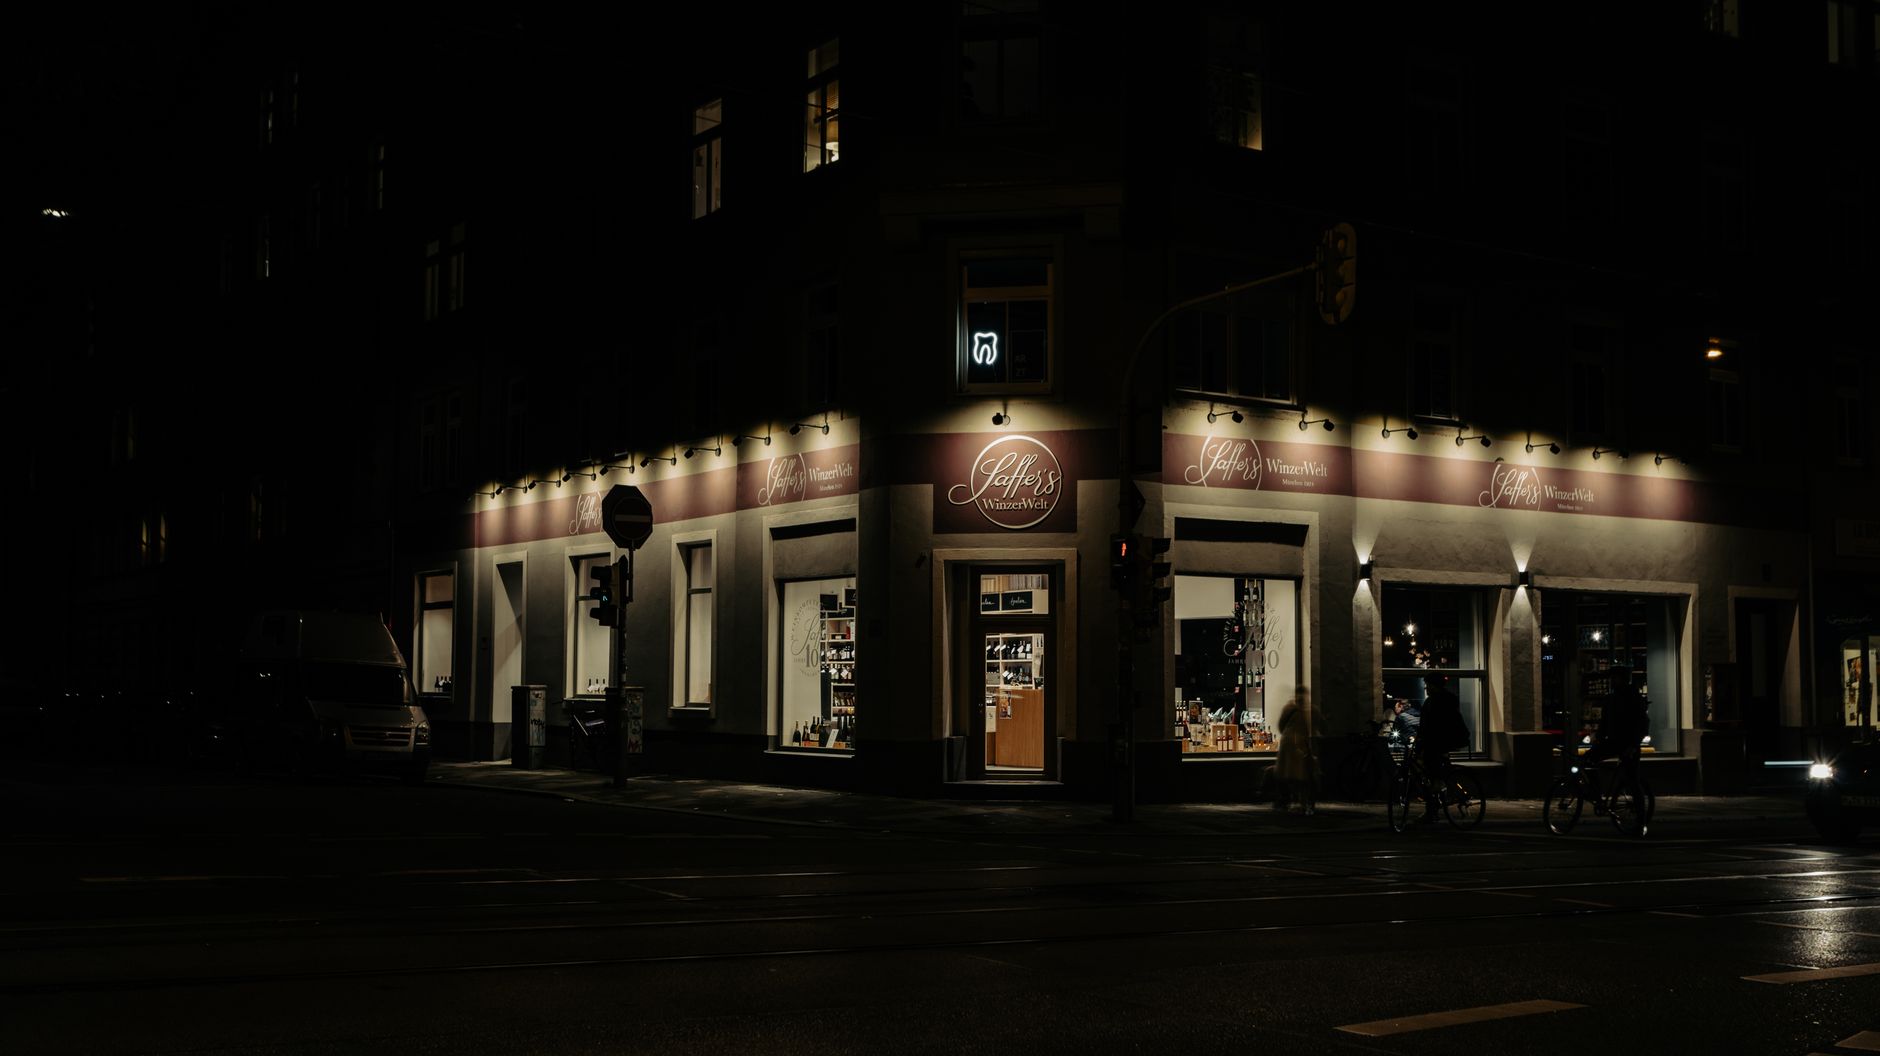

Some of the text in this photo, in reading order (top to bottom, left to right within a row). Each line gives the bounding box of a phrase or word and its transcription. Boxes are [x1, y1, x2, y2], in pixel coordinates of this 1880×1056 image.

[808, 463, 853, 482] WinzerWelt
[1266, 457, 1327, 477] WinzerWelt
[948, 452, 1061, 505] Saffer's
[1544, 484, 1595, 503] WinzerWelt
[982, 498, 1049, 511] WinzerWelt
